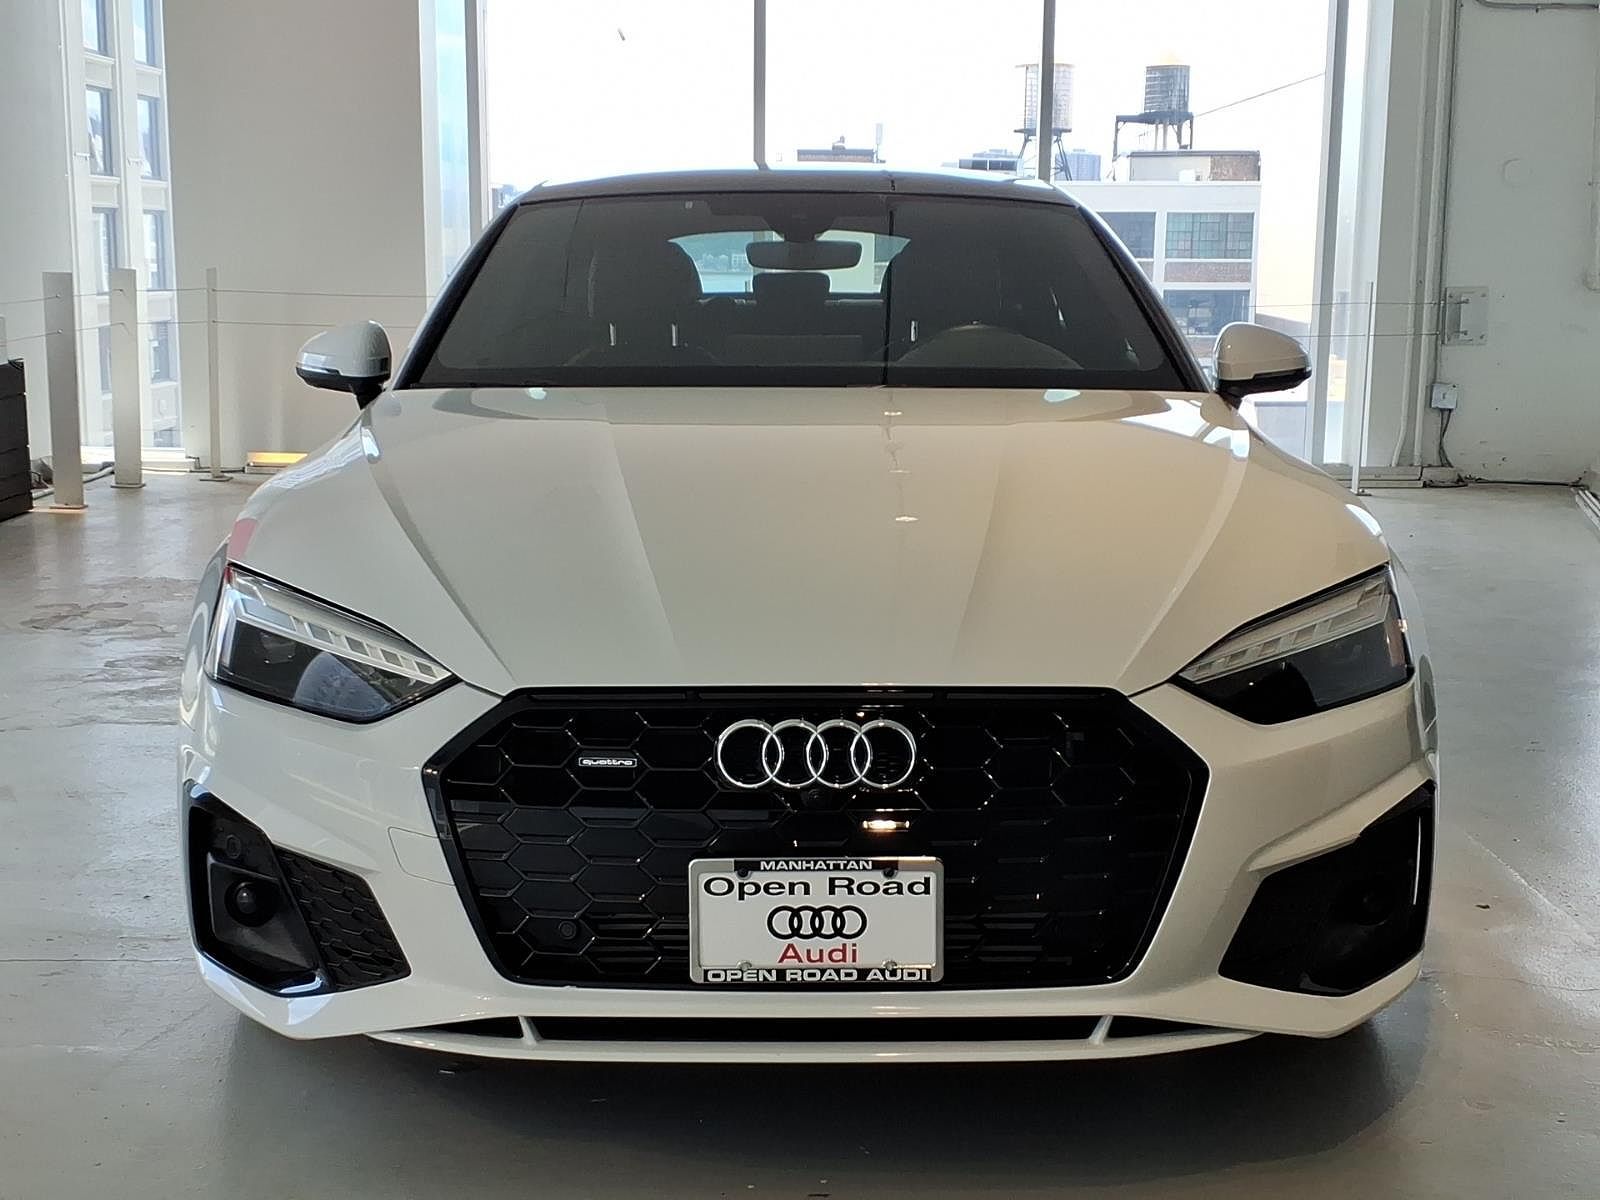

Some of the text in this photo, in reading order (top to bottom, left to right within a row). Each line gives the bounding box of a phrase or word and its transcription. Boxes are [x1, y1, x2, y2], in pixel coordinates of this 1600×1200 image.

[760, 860, 872, 870] MANHATTAN
[703, 876, 931, 901] Open Road
[777, 943, 858, 964] Audi
[707, 968, 928, 982] OPEN ROAD AUDI
